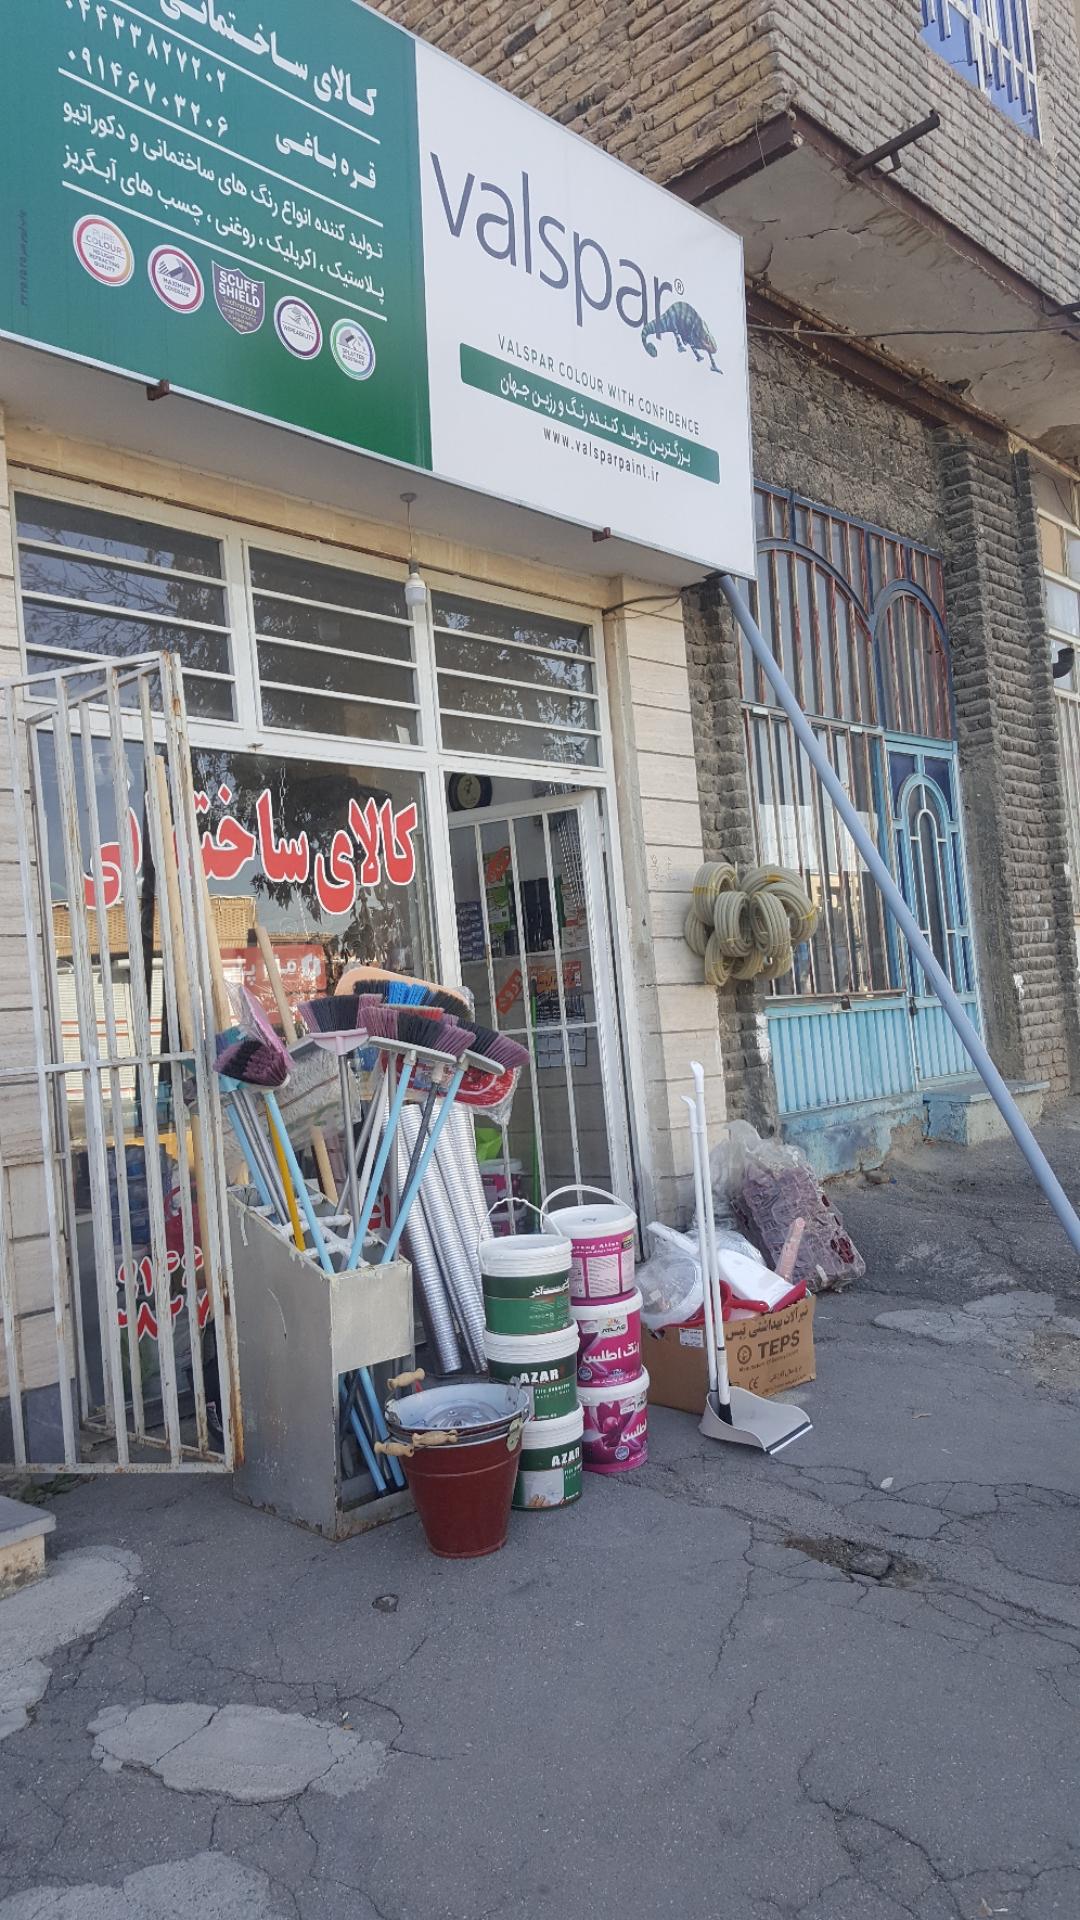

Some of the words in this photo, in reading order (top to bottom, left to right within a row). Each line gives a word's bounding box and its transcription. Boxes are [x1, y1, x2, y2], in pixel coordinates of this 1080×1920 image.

[67, 47, 229, 138] ۰۹۱۴۶۷۰۳۲۰۶
[313, 64, 377, 116] کالای
[63, 101, 126, 139] دکوراتیو
[129, 132, 140, 153] و
[275, 131, 338, 178] باغی
[63, 144, 117, 184] آبگریز
[143, 138, 215, 181] ساختمانی
[120, 171, 154, 197] های
[218, 172, 248, 196] های
[157, 188, 204, 225] چسب
[251, 184, 279, 217] رنگ
[281, 200, 312, 229] انواع
[314, 217, 346, 241] کننده
[86, 234, 123, 255] COLOUR
[349, 232, 384, 260] تولید
[218, 282, 260, 308] SHIELD
[219, 270, 258, 294] SCUFF
[498, 333, 554, 373] VALSPAR
[558, 361, 604, 394] COLOUR
[608, 383, 635, 407] WITH
[638, 397, 700, 436] CONFIDENCE
[500, 372, 530, 400] جهان
[531, 391, 558, 415] رزین
[565, 397, 589, 427] رنگ
[589, 415, 619, 435] کننده
[620, 424, 648, 449] تولید
[543, 427, 660, 483] www.valsparpaint.ir
[649, 439, 692, 467] بزرگترین
[314, 797, 418, 915] کالای
[757, 1330, 800, 1360] TEPS
[519, 1368, 560, 1384] AZAR
[551, 1446, 581, 1468] AZAR
